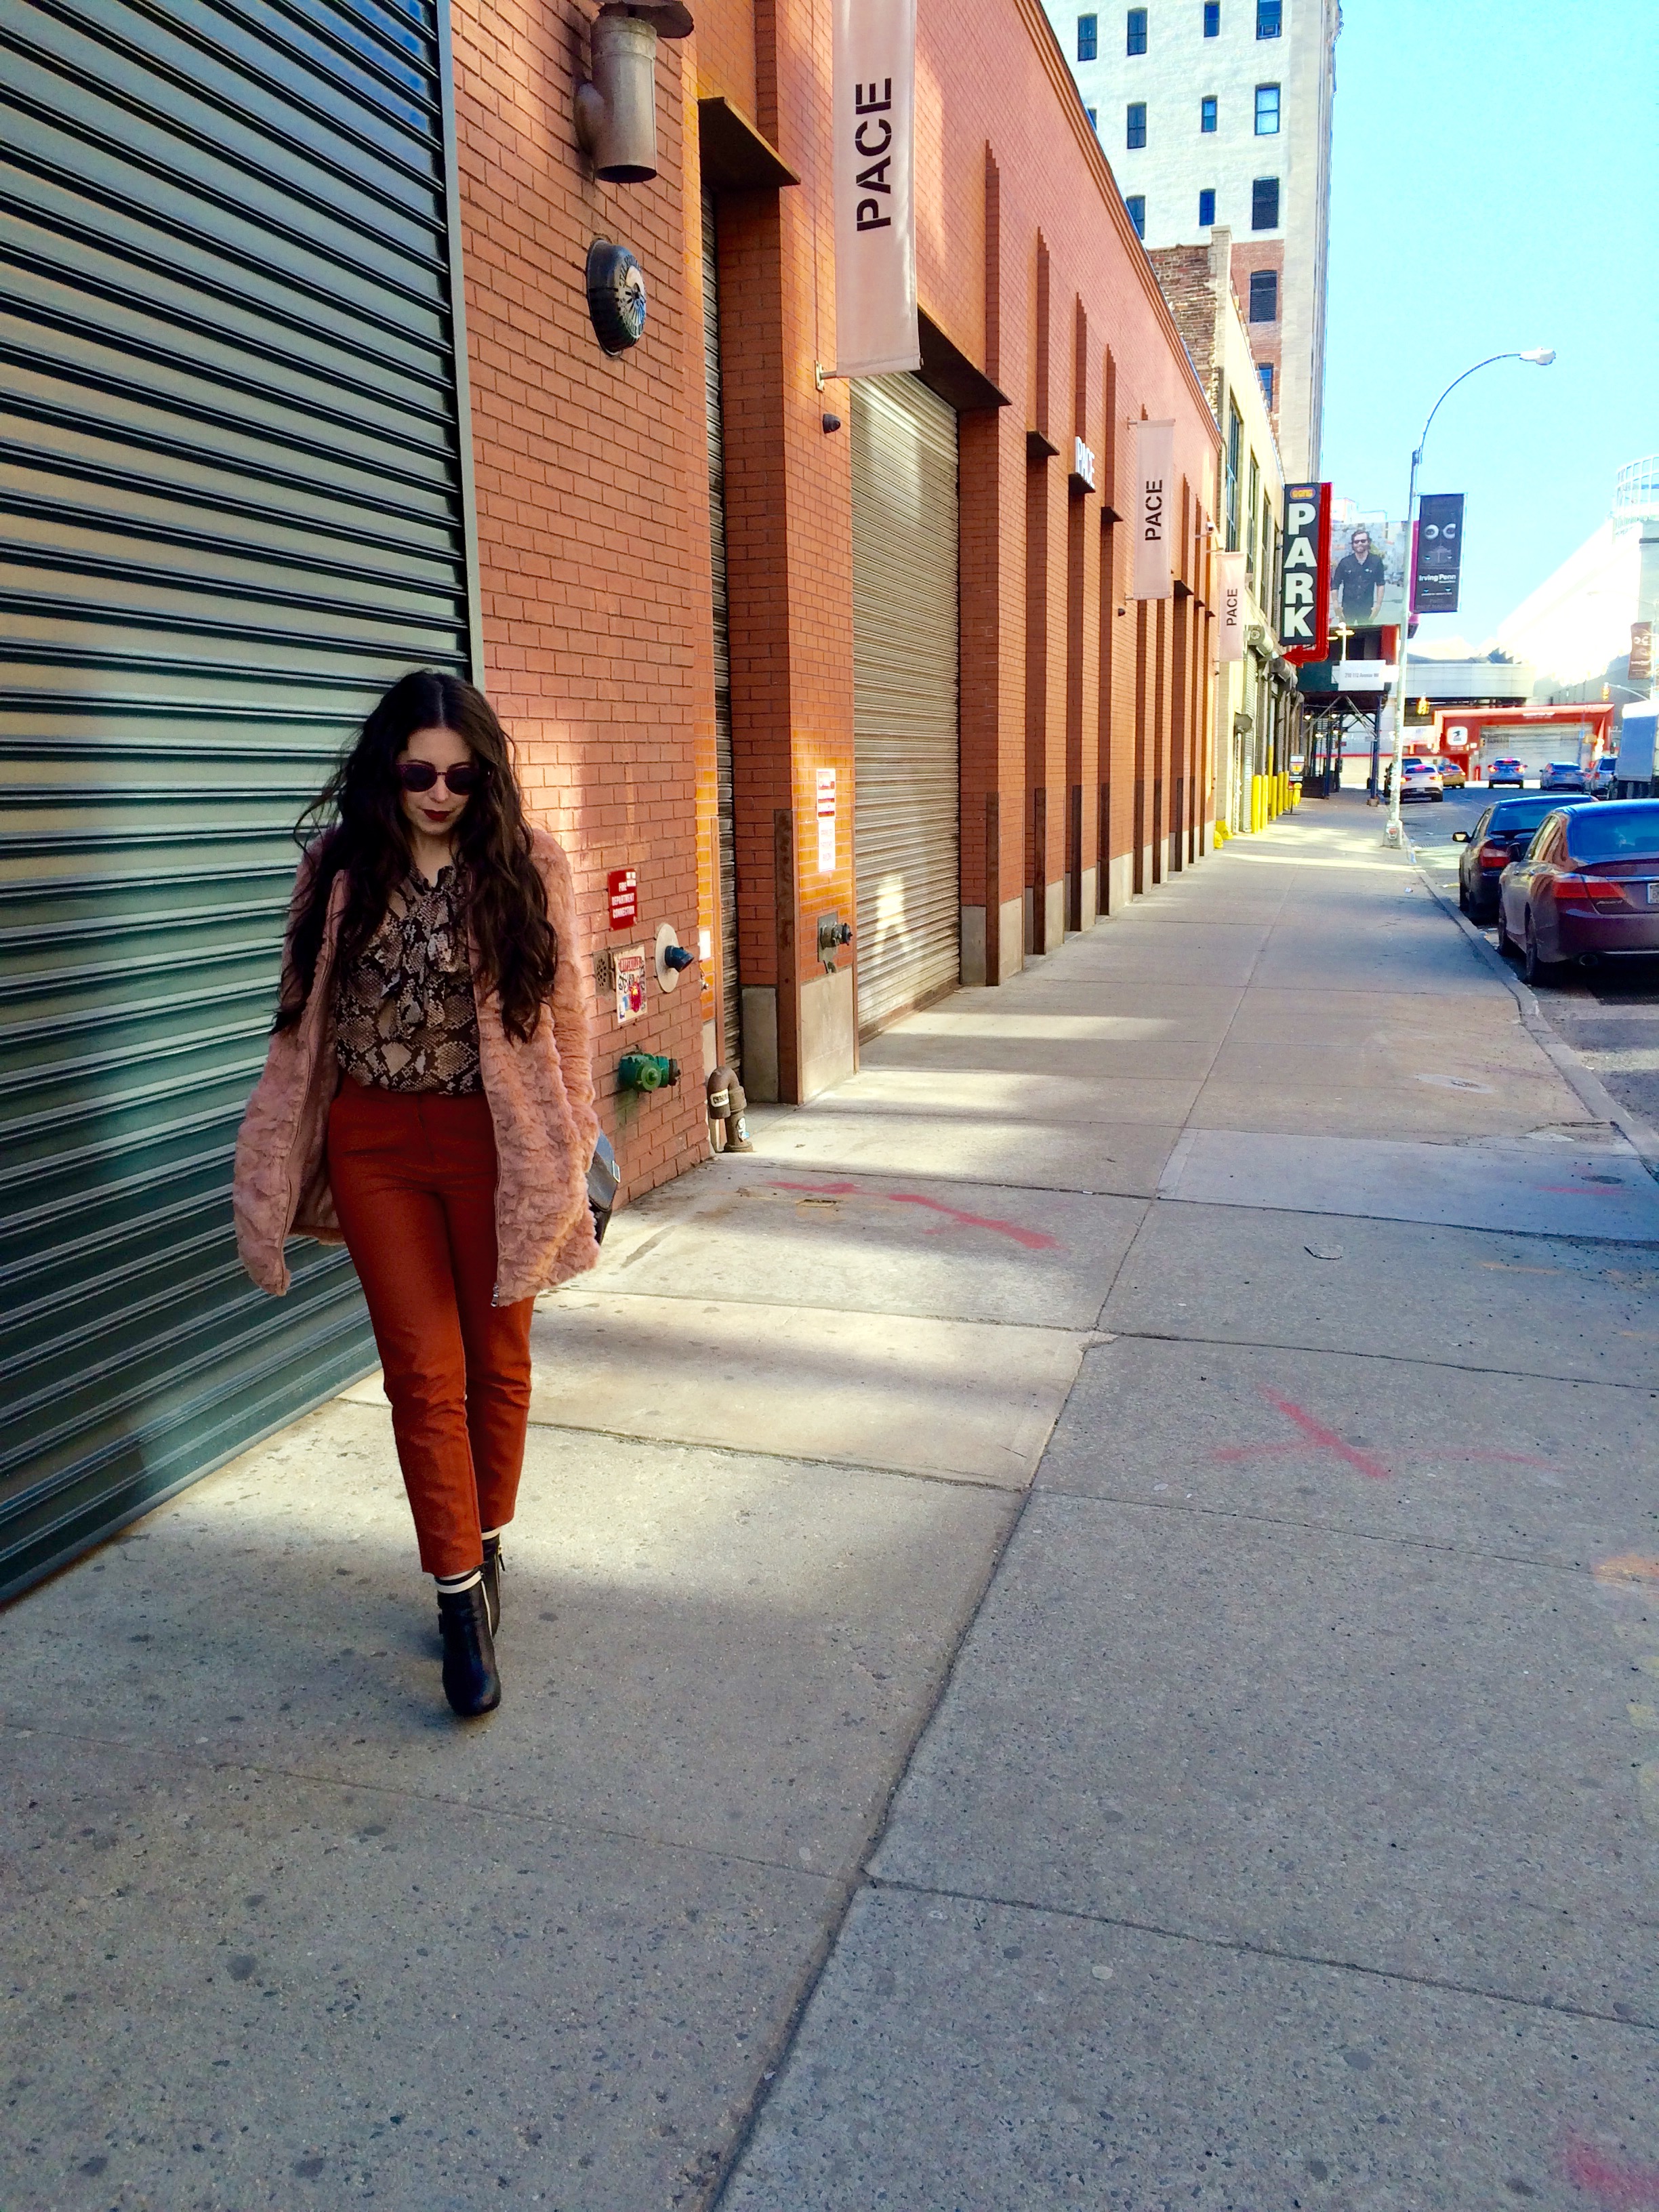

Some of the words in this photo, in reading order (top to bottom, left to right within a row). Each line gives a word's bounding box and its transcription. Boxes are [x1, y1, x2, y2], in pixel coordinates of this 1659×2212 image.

[856, 78, 891, 231] PACE
[1075, 436, 1094, 489] PACE
[1145, 479, 1162, 541] PACE
[1284, 503, 1317, 637] PARK
[1226, 588, 1238, 627] PACE
